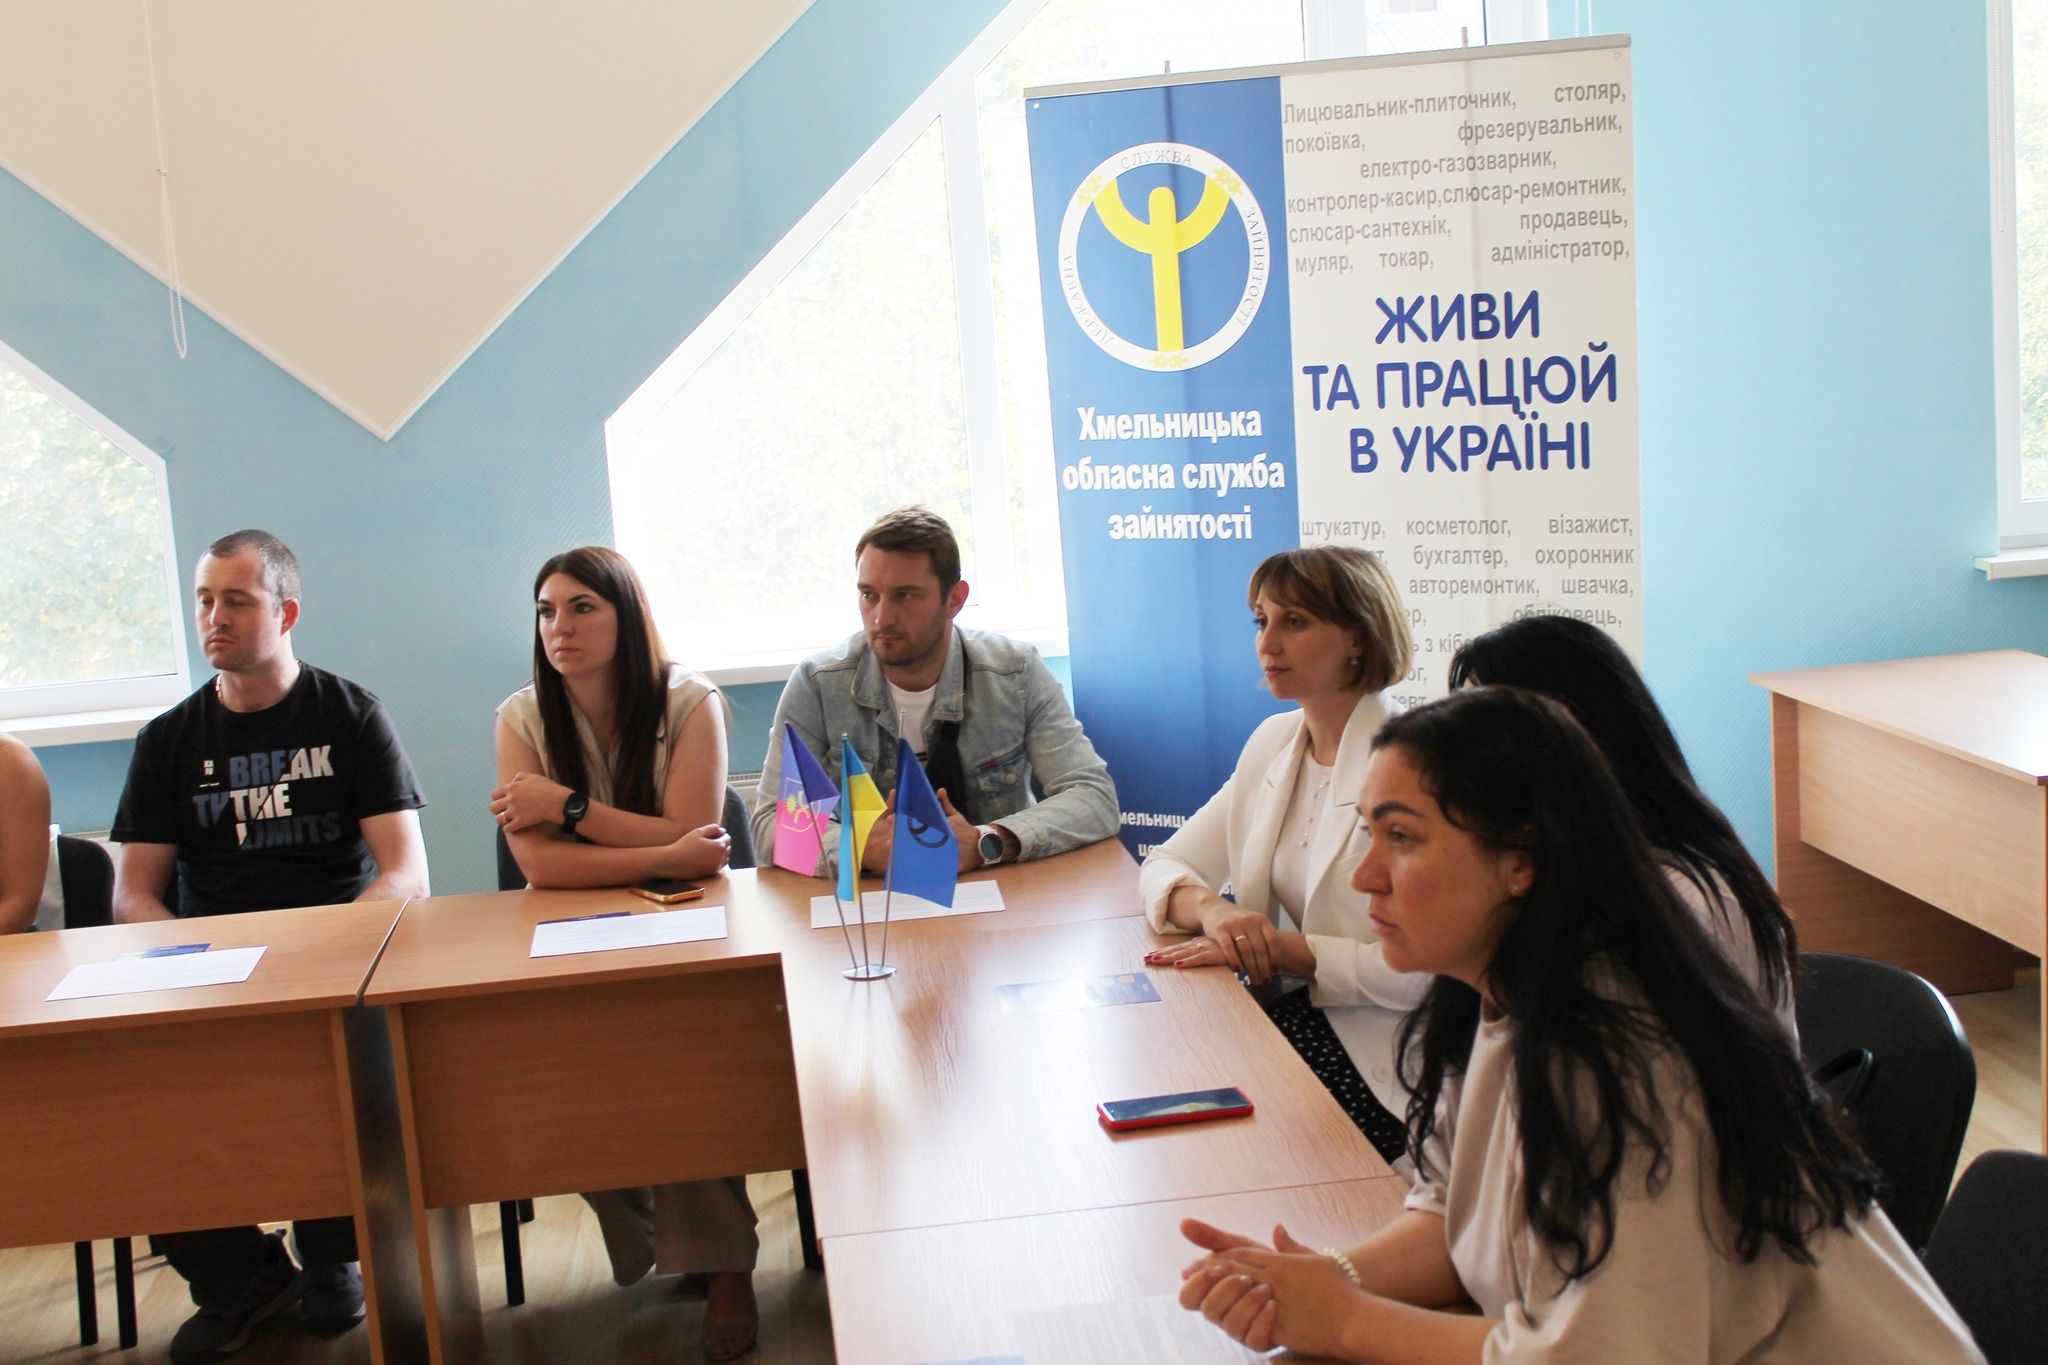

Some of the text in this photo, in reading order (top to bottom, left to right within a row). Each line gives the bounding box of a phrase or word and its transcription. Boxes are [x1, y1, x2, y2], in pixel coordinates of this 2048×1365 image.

[1284, 82, 1626, 125] Лицювальник-плиточник, столяр,
[1285, 114, 1623, 154] покоївка, фрезерувальник,
[1120, 149, 1193, 169] СЛУЖБА
[1360, 149, 1557, 180] електро-газозварник,
[1289, 207, 1628, 245] слюсар-сантехнік, продавець,
[1295, 238, 1630, 277] муляр, токар, адміністратор,
[1375, 290, 1540, 345] ЖИВИ
[1302, 341, 1617, 414] ТА ПРАЦЮЙ
[1077, 406, 1262, 443] Хмельницька
[1350, 410, 1590, 473] В УКРАЇНІ
[1062, 452, 1286, 498] обласна служба
[1108, 505, 1252, 540] зайнятості
[1302, 514, 1633, 540] штукатур, косметолог, візажист,
[1413, 545, 1508, 569] бухгалтер,
[1535, 547, 1634, 569] охоронник
[1409, 577, 1634, 599] авторемонтик, швачка,
[229, 745, 334, 789] BREAK
[230, 783, 292, 821] THE
